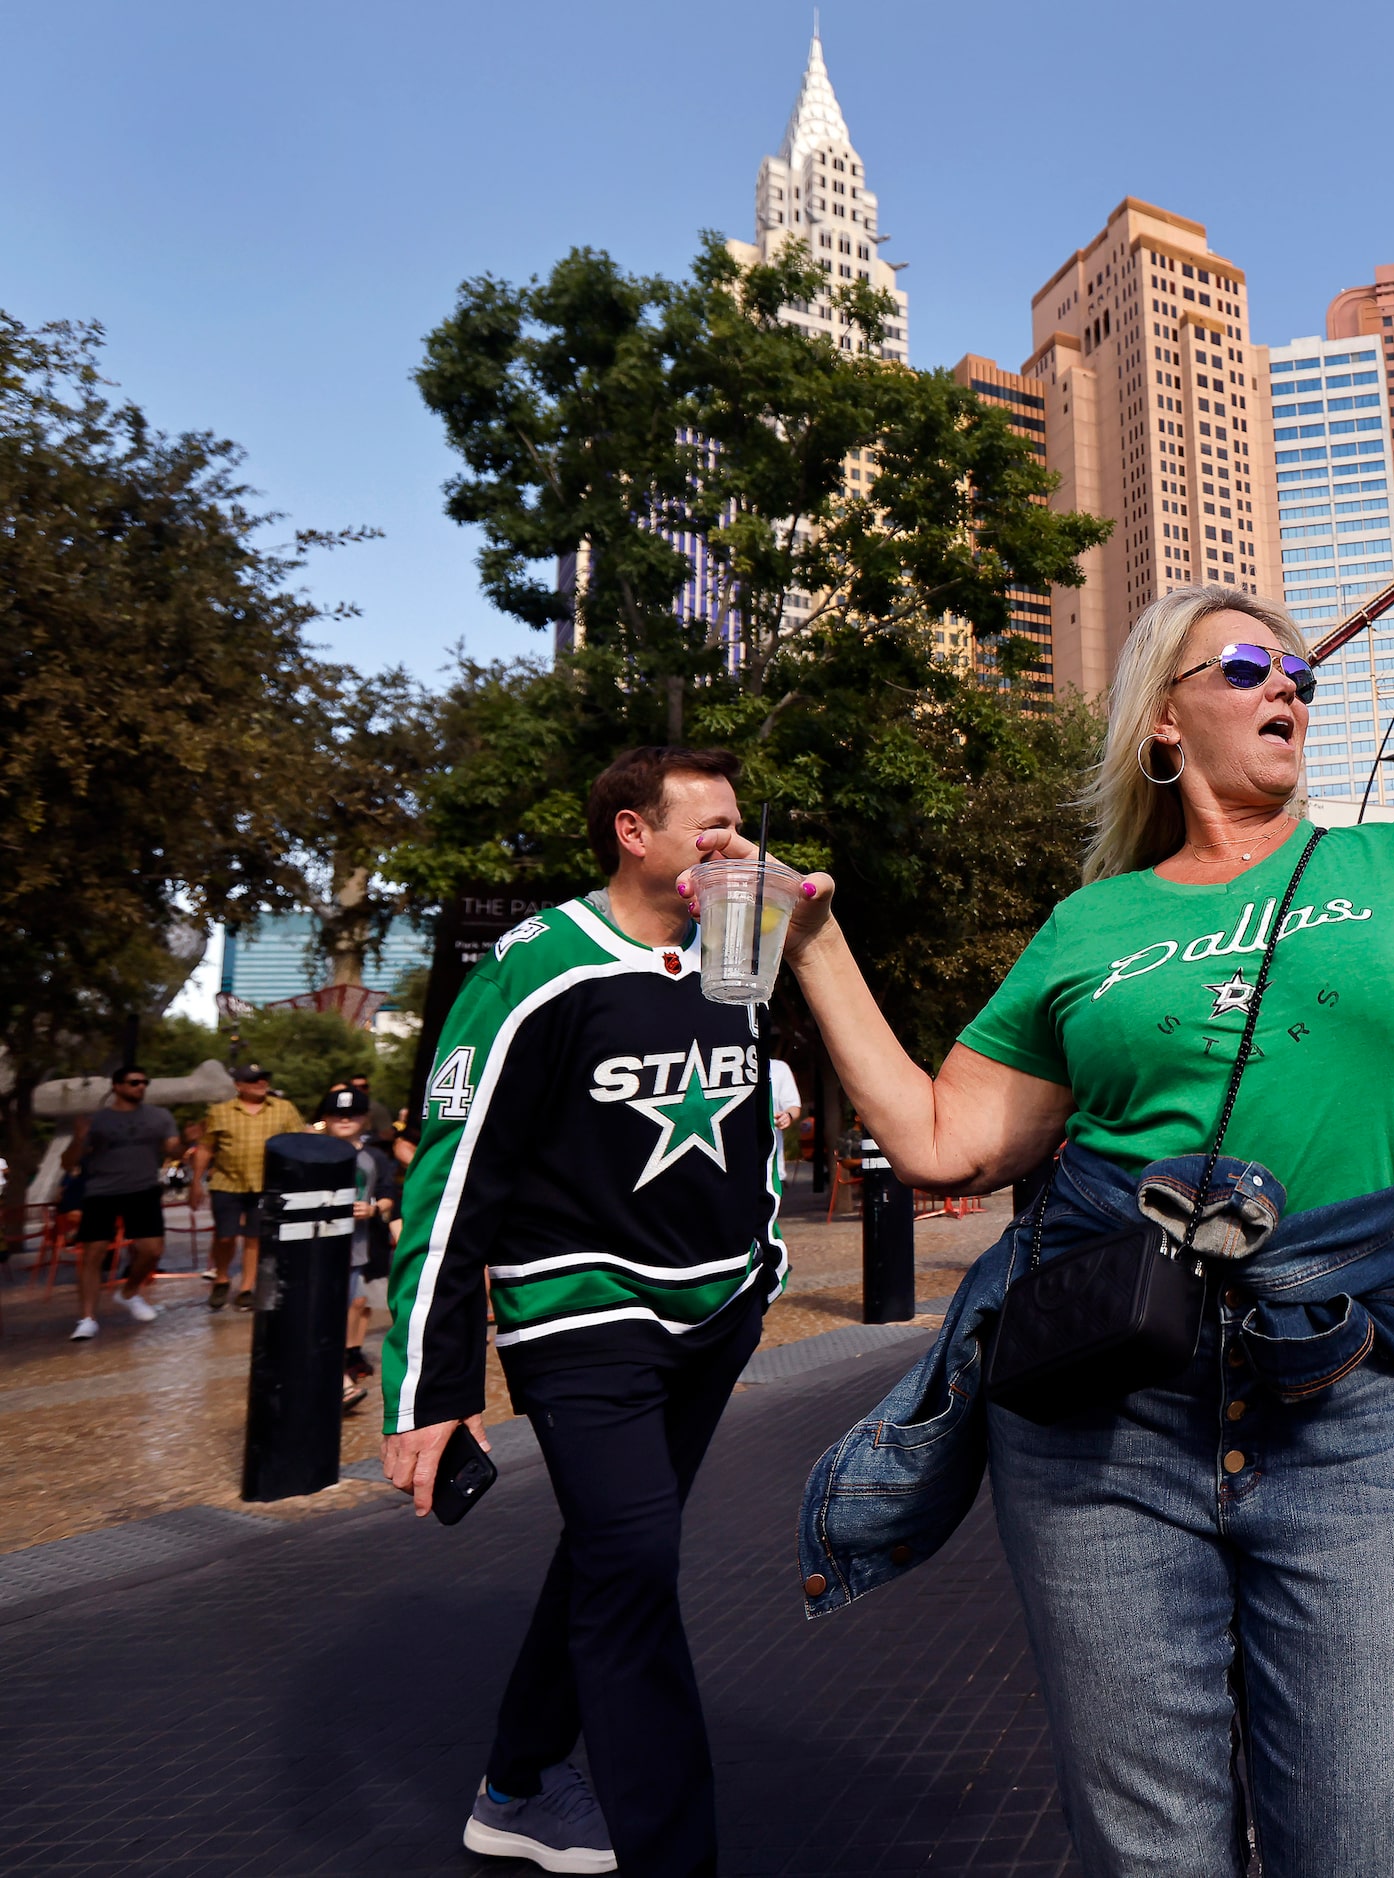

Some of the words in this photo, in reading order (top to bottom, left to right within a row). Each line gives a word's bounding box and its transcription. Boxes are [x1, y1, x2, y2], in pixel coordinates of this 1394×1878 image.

[463, 897, 504, 917] THE
[1090, 896, 1373, 1003] Dallas
[1156, 981, 1341, 1059] STARS
[422, 1045, 476, 1120] 4
[588, 1039, 759, 1103] STARS
